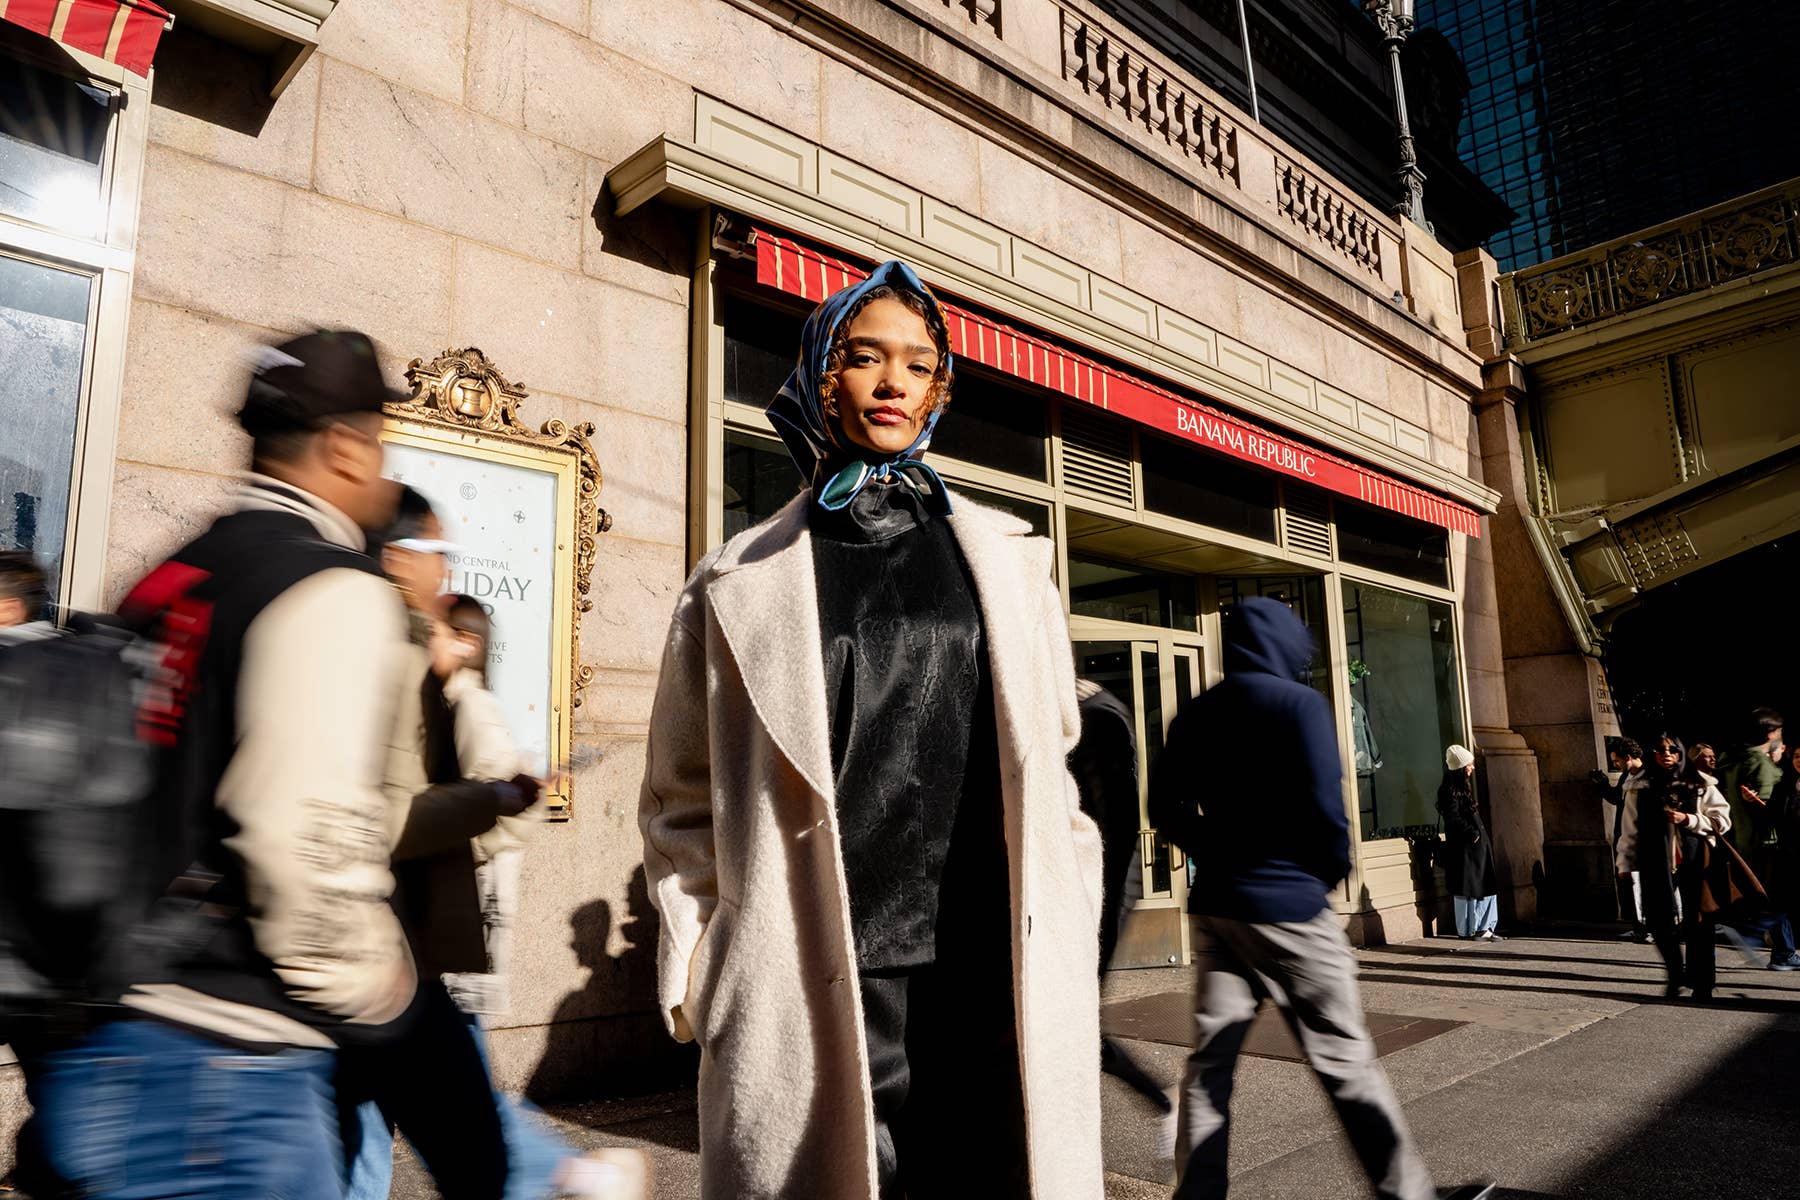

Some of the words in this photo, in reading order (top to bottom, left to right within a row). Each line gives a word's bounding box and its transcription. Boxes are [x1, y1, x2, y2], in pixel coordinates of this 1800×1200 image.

[1177, 407, 1246, 453] BANANA
[1248, 434, 1316, 477] REPUBLIC
[462, 555, 511, 572] CENTRAL
[447, 569, 532, 601] LIDAY
